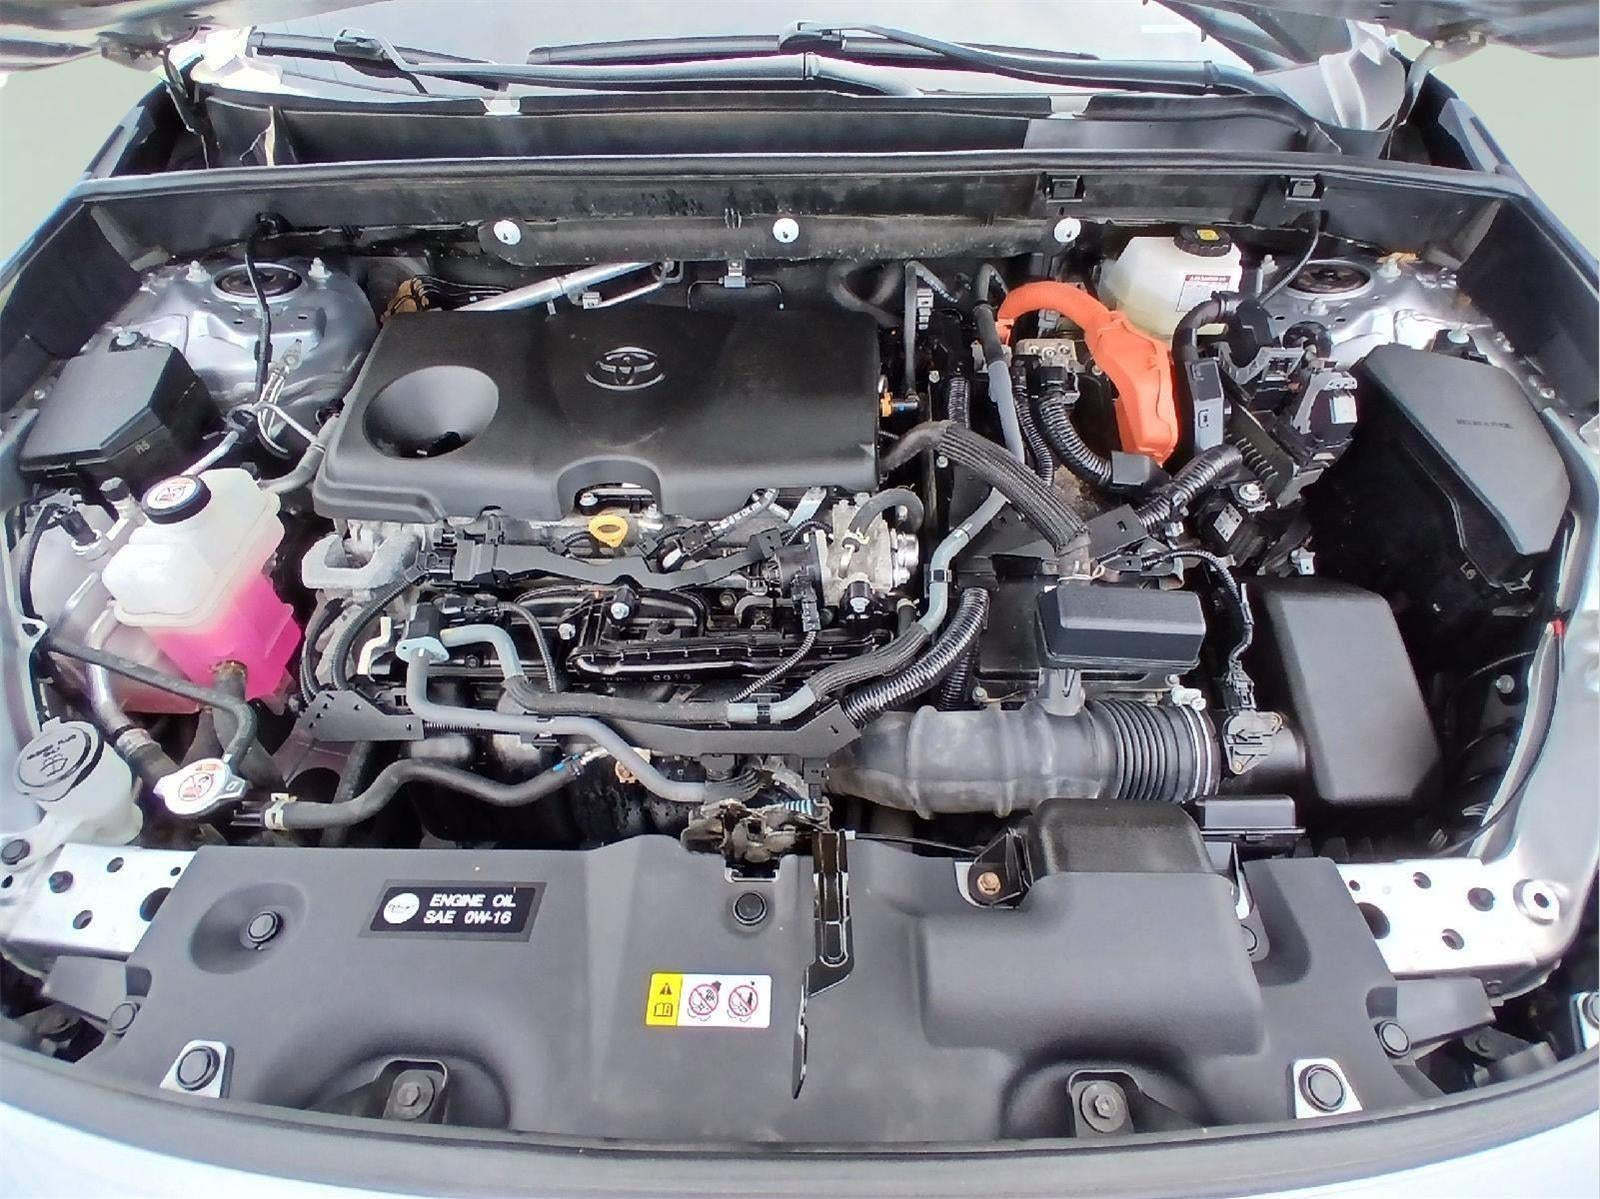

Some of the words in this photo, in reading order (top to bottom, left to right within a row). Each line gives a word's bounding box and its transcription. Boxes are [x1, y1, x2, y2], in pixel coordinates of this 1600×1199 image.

[429, 893, 486, 907] ENGINE
[492, 893, 516, 907] OIL
[423, 910, 456, 924] SAE
[464, 910, 512, 924] 0W-16
